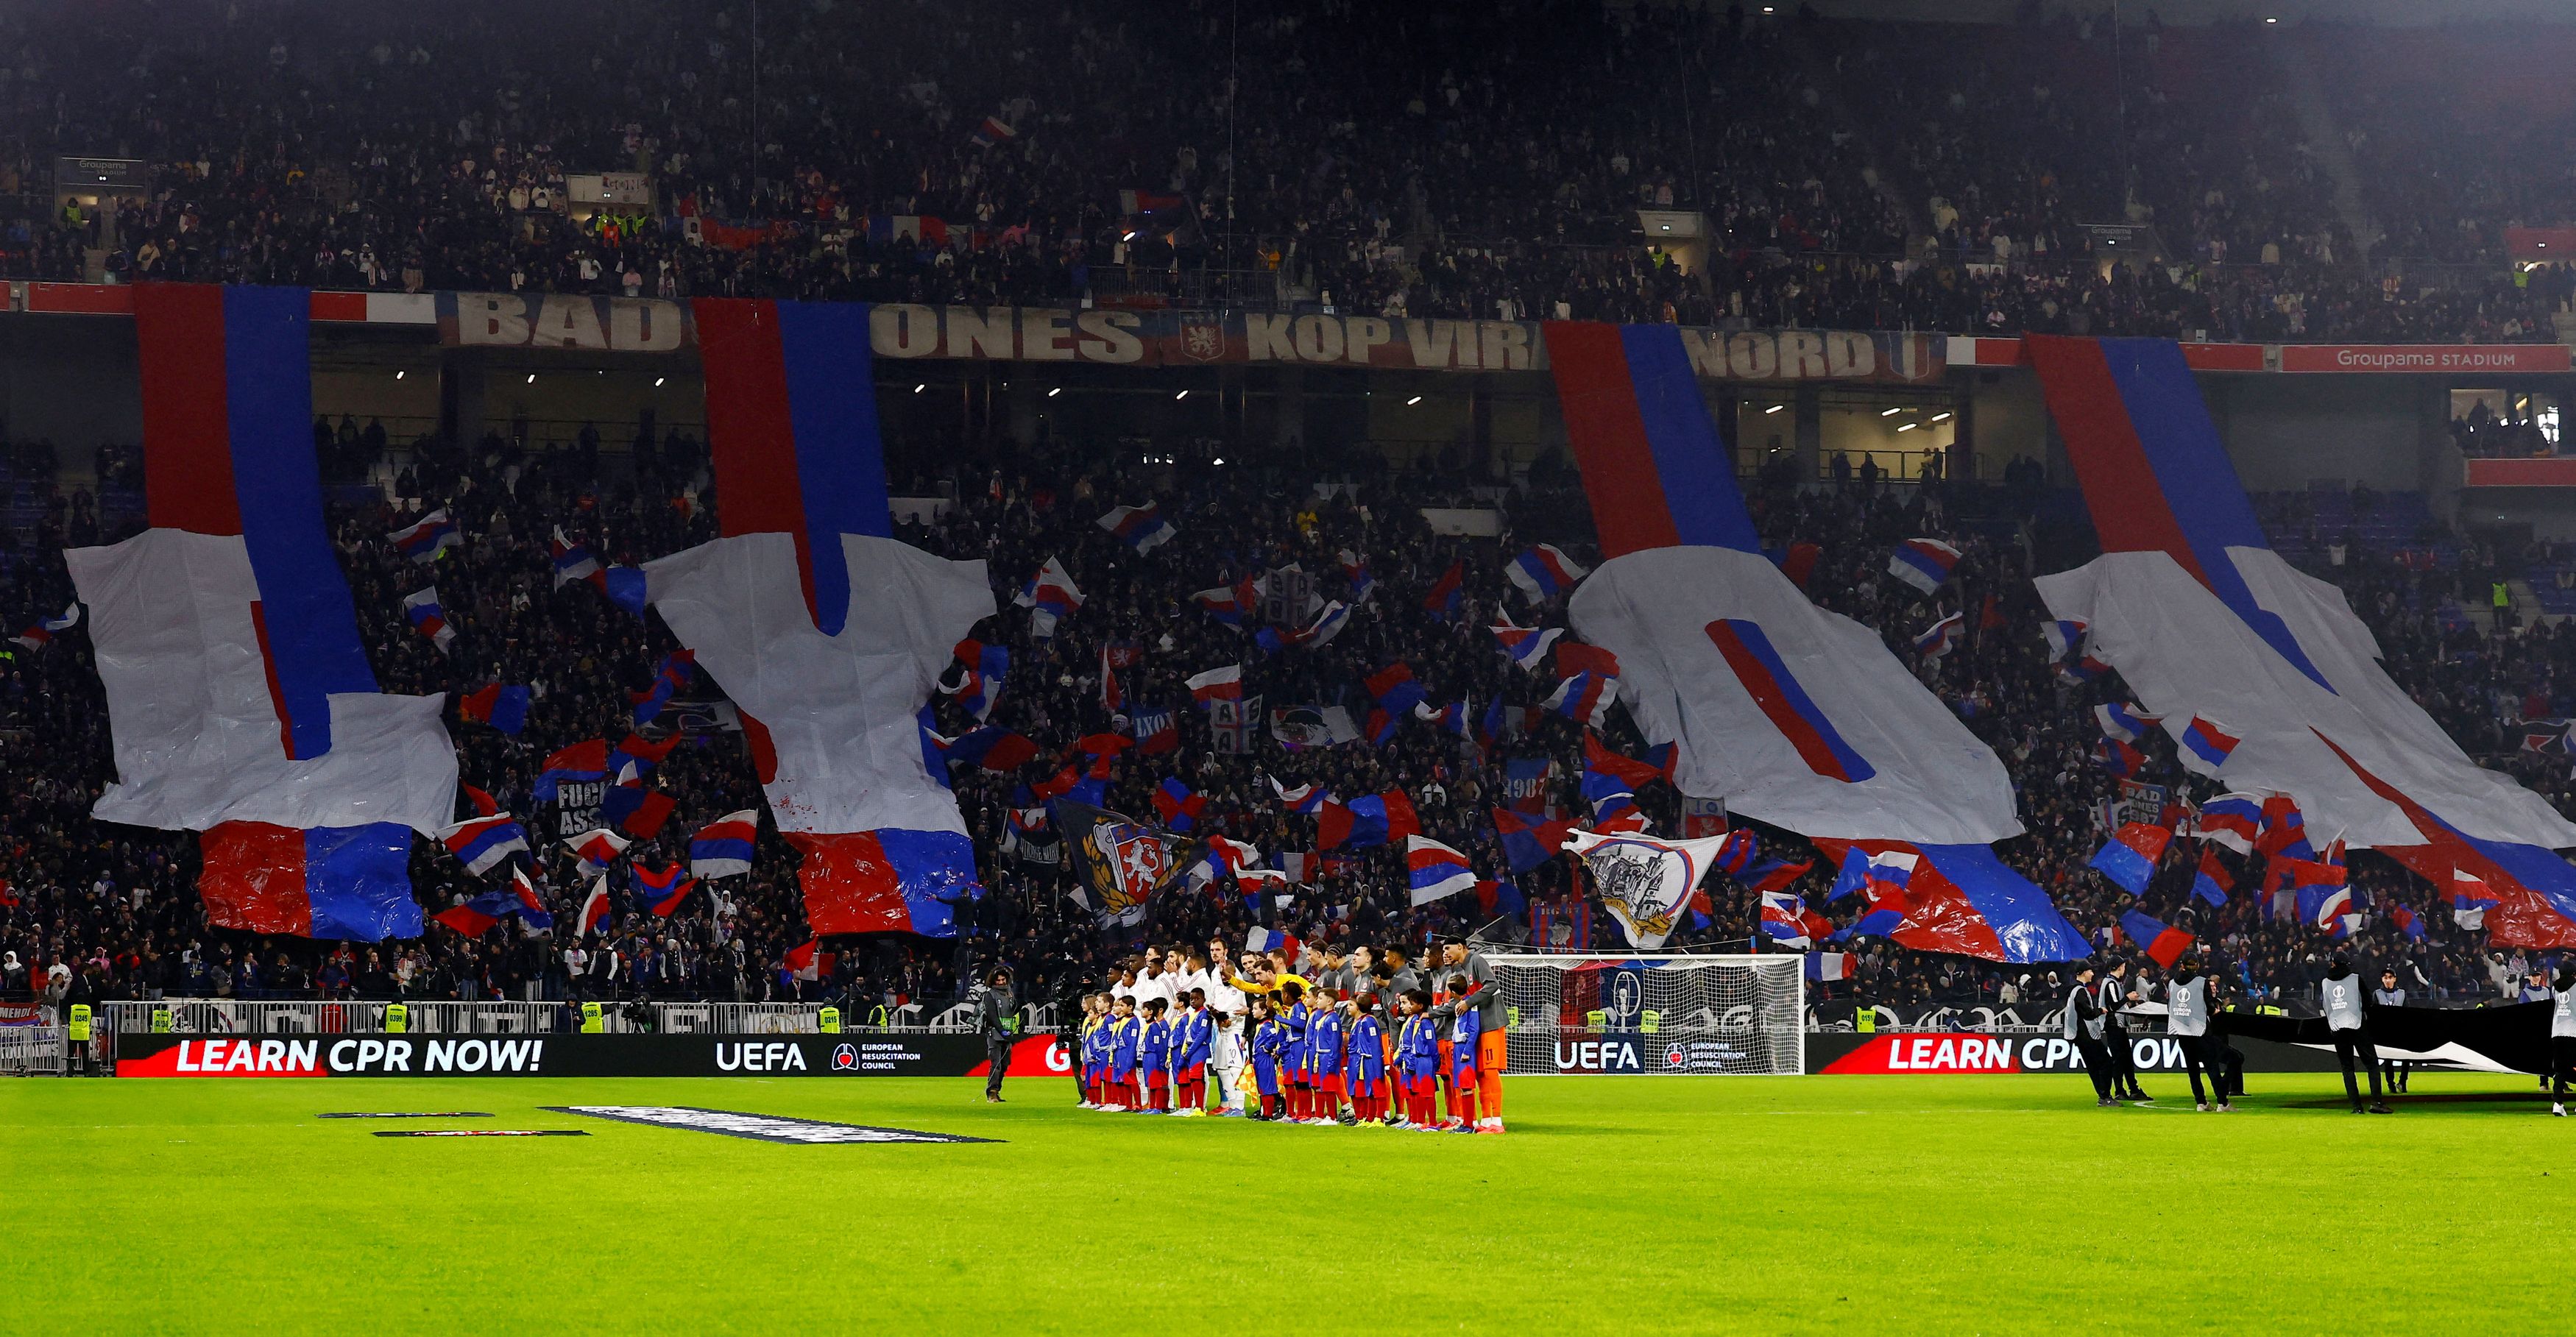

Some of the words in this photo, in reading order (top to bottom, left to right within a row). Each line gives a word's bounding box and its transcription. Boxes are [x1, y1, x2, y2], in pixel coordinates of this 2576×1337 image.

[79, 160, 127, 170] Groupama
[457, 292, 682, 351] BAD
[869, 302, 1144, 363] ONES
[1245, 313, 1391, 361] KOP
[1680, 327, 1875, 378] NORD
[2337, 350, 2435, 369] Groupama
[2441, 354, 2516, 366] STADIUM
[1135, 709, 1176, 737] LYON
[1507, 778, 1546, 798] 1987
[2125, 787, 2161, 802] BAD
[389, 1014, 403, 1022] 0399
[584, 1010, 598, 1018] 1285
[177, 1040, 319, 1072] LEARN
[329, 1039, 412, 1072] CPR
[425, 1040, 541, 1072] NOW!
[716, 1043, 807, 1071] UEFA
[862, 1053, 921, 1061] RESUSCITATION
[1485, 1048, 1493, 1061] 11
[1554, 1042, 1640, 1069] UEFA
[1888, 1038, 2013, 1068] LEARN
